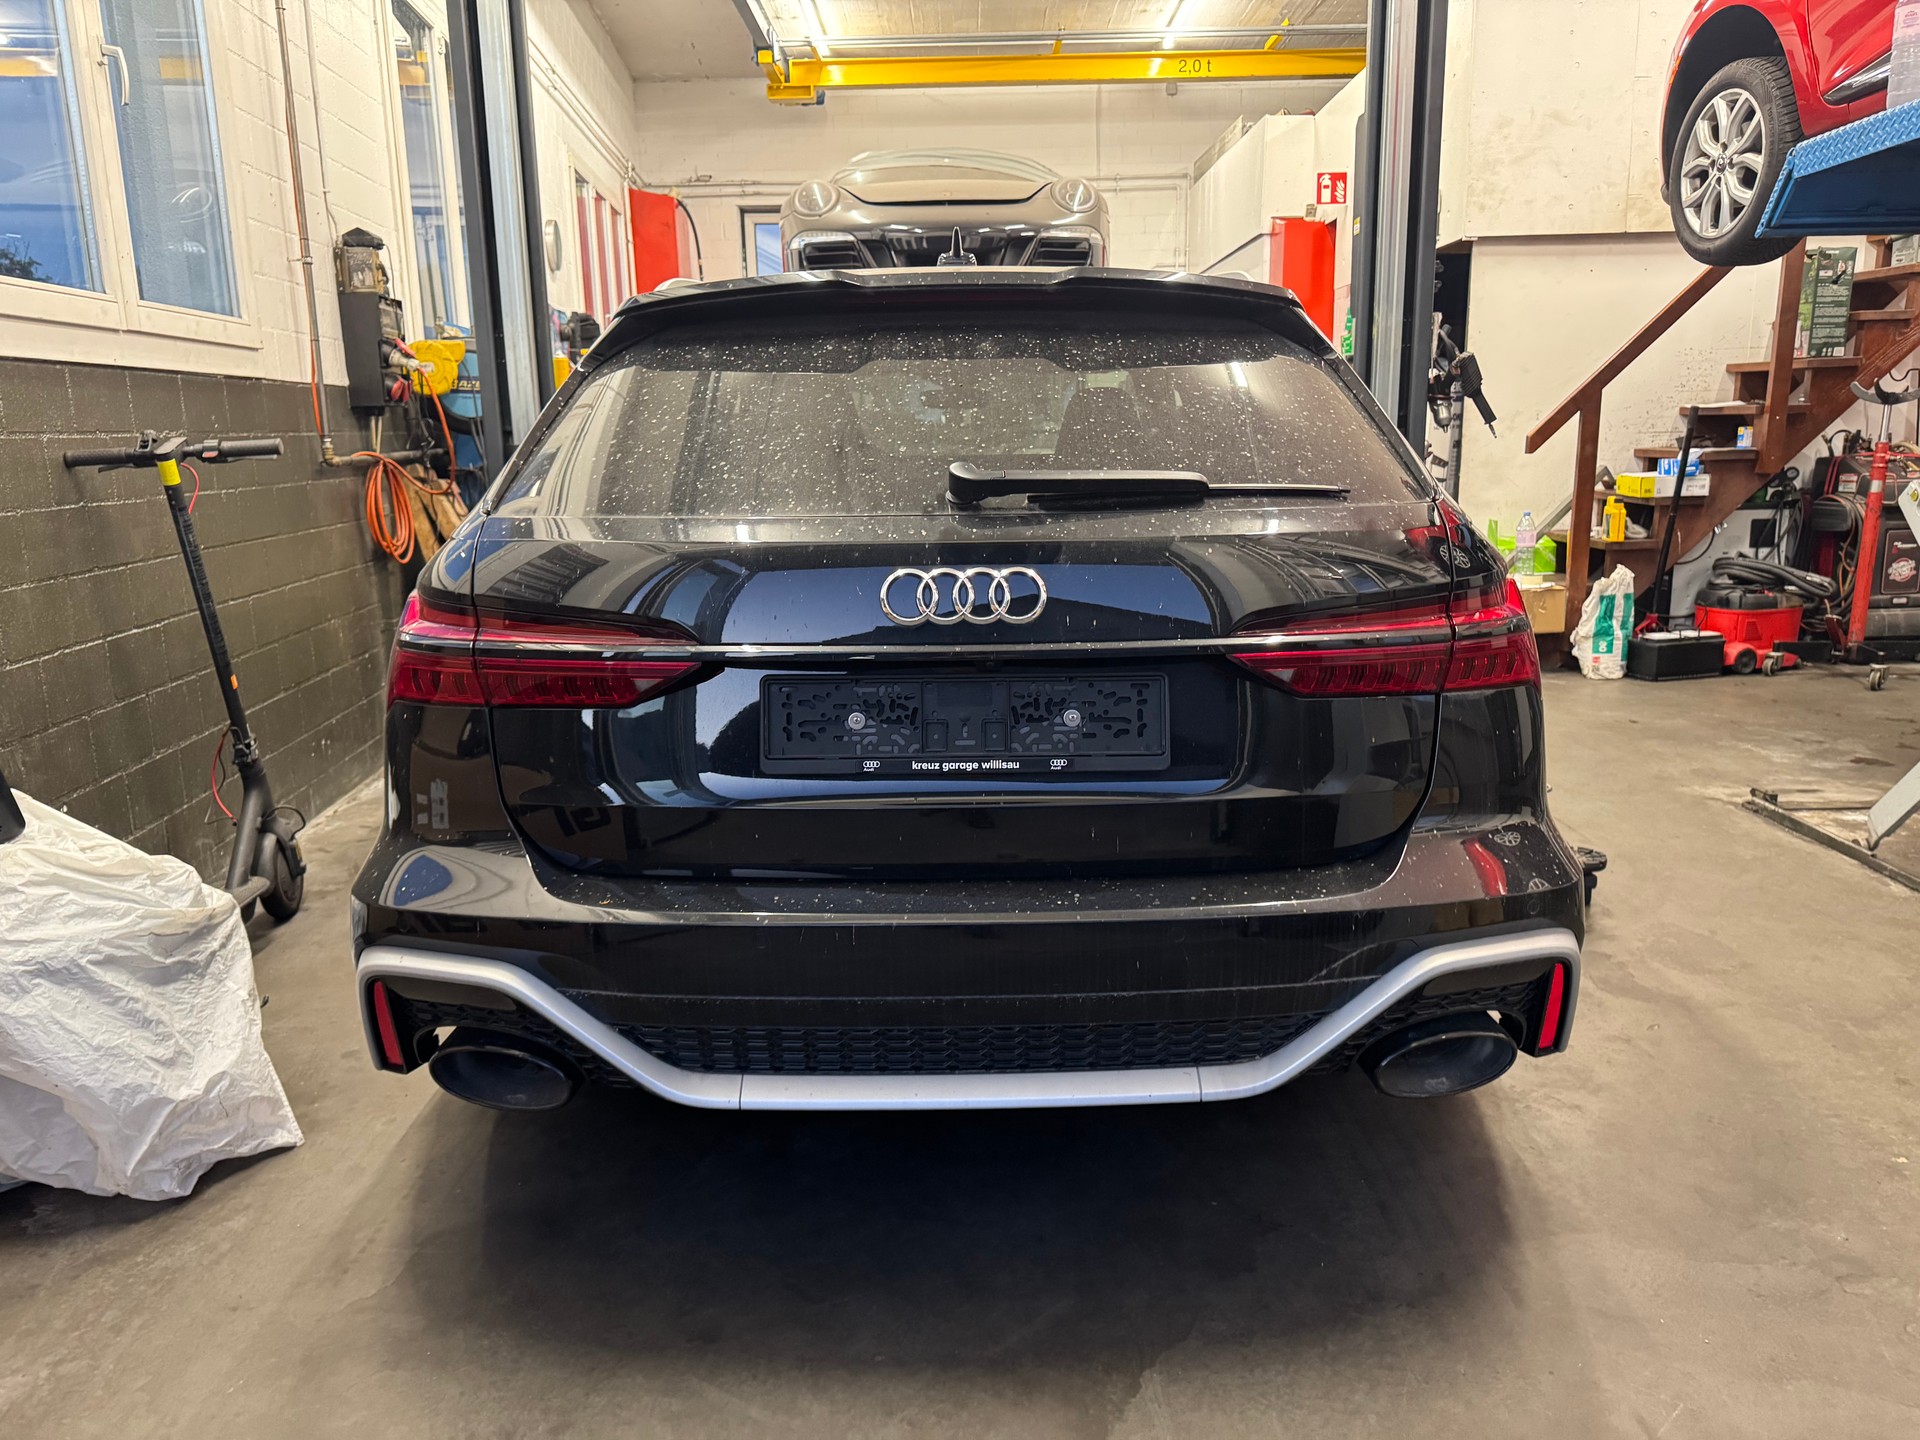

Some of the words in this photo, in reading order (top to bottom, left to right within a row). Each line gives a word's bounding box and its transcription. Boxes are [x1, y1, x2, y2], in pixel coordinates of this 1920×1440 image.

[1178, 59, 1202, 76] 2,0
[1206, 59, 1212, 73] t
[912, 760, 940, 770] kreuz
[942, 761, 979, 772] garage
[981, 759, 1020, 769] willisau
